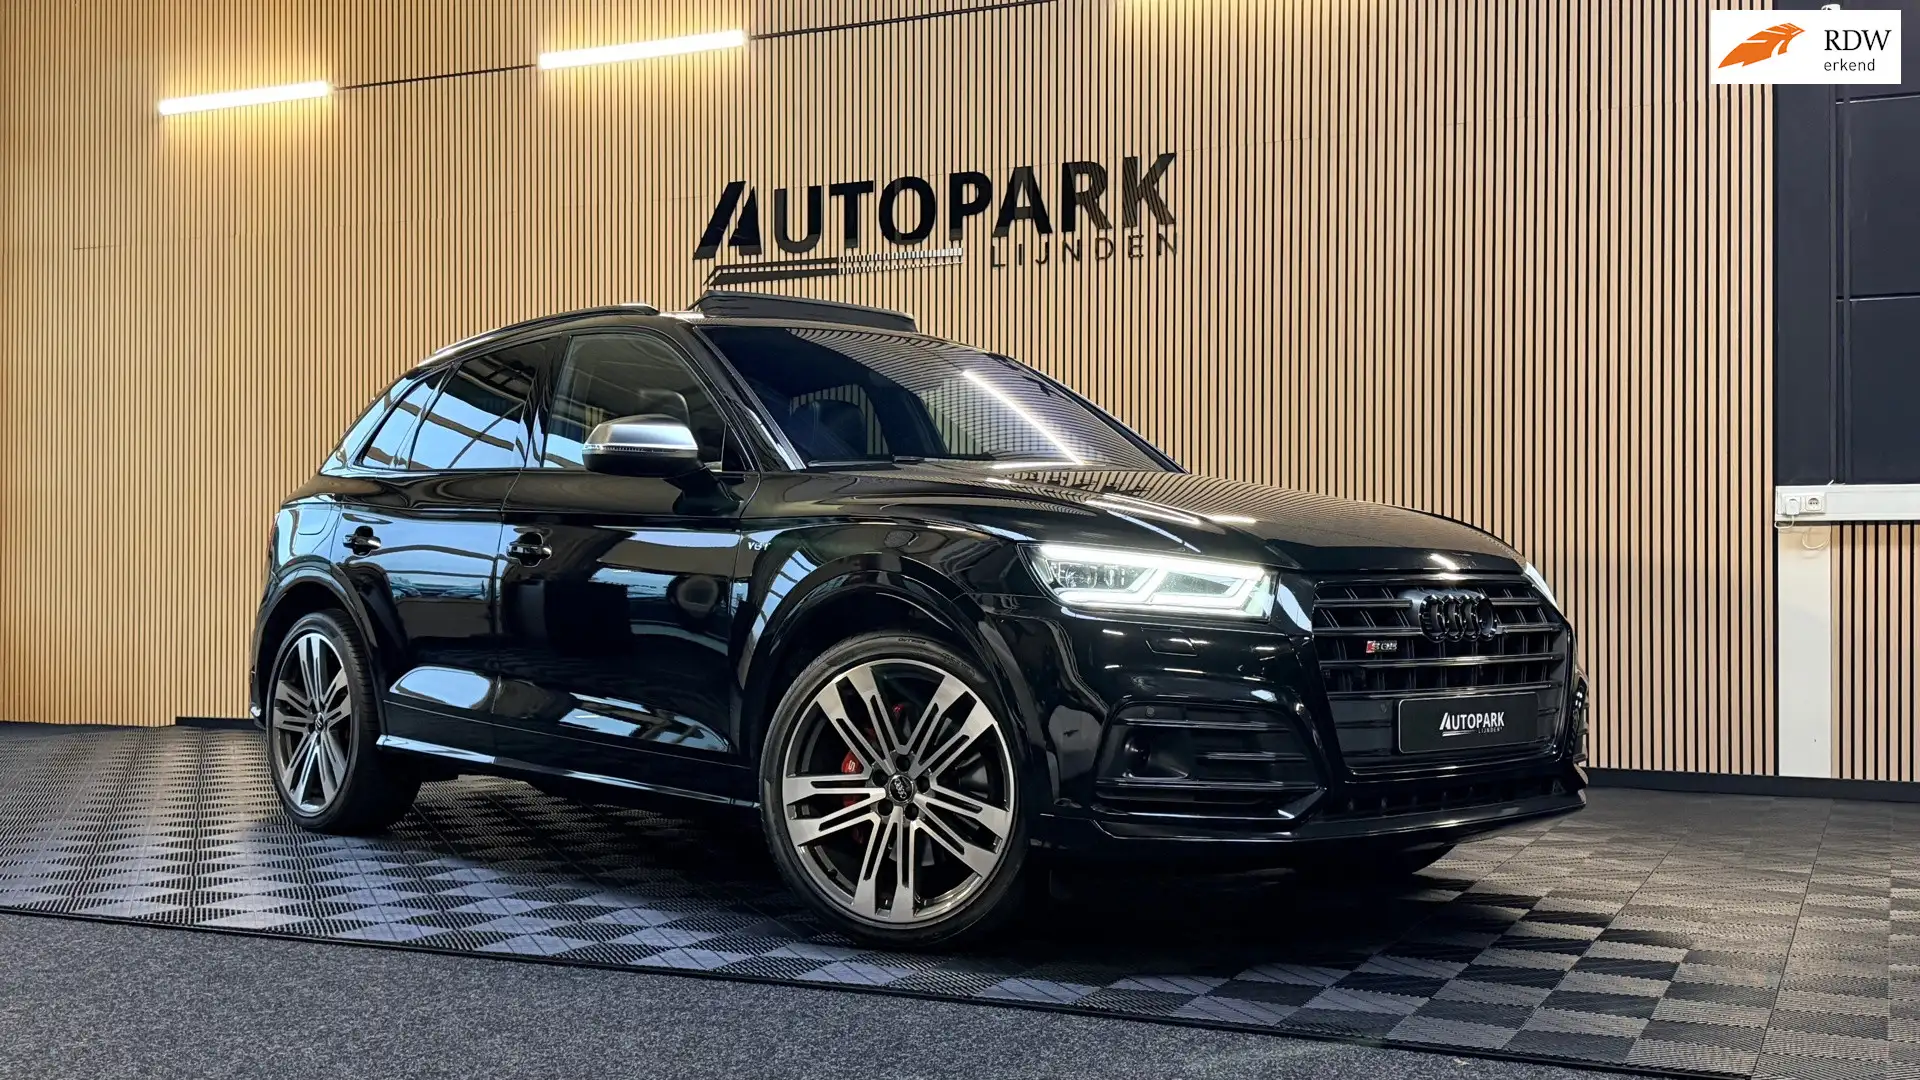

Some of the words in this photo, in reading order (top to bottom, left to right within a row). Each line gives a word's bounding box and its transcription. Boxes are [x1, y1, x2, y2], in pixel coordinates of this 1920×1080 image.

[693, 152, 1177, 260] AUTOPARK
[991, 232, 1178, 268] LIJNDEN
[1439, 711, 1505, 731] AUTOPARK
